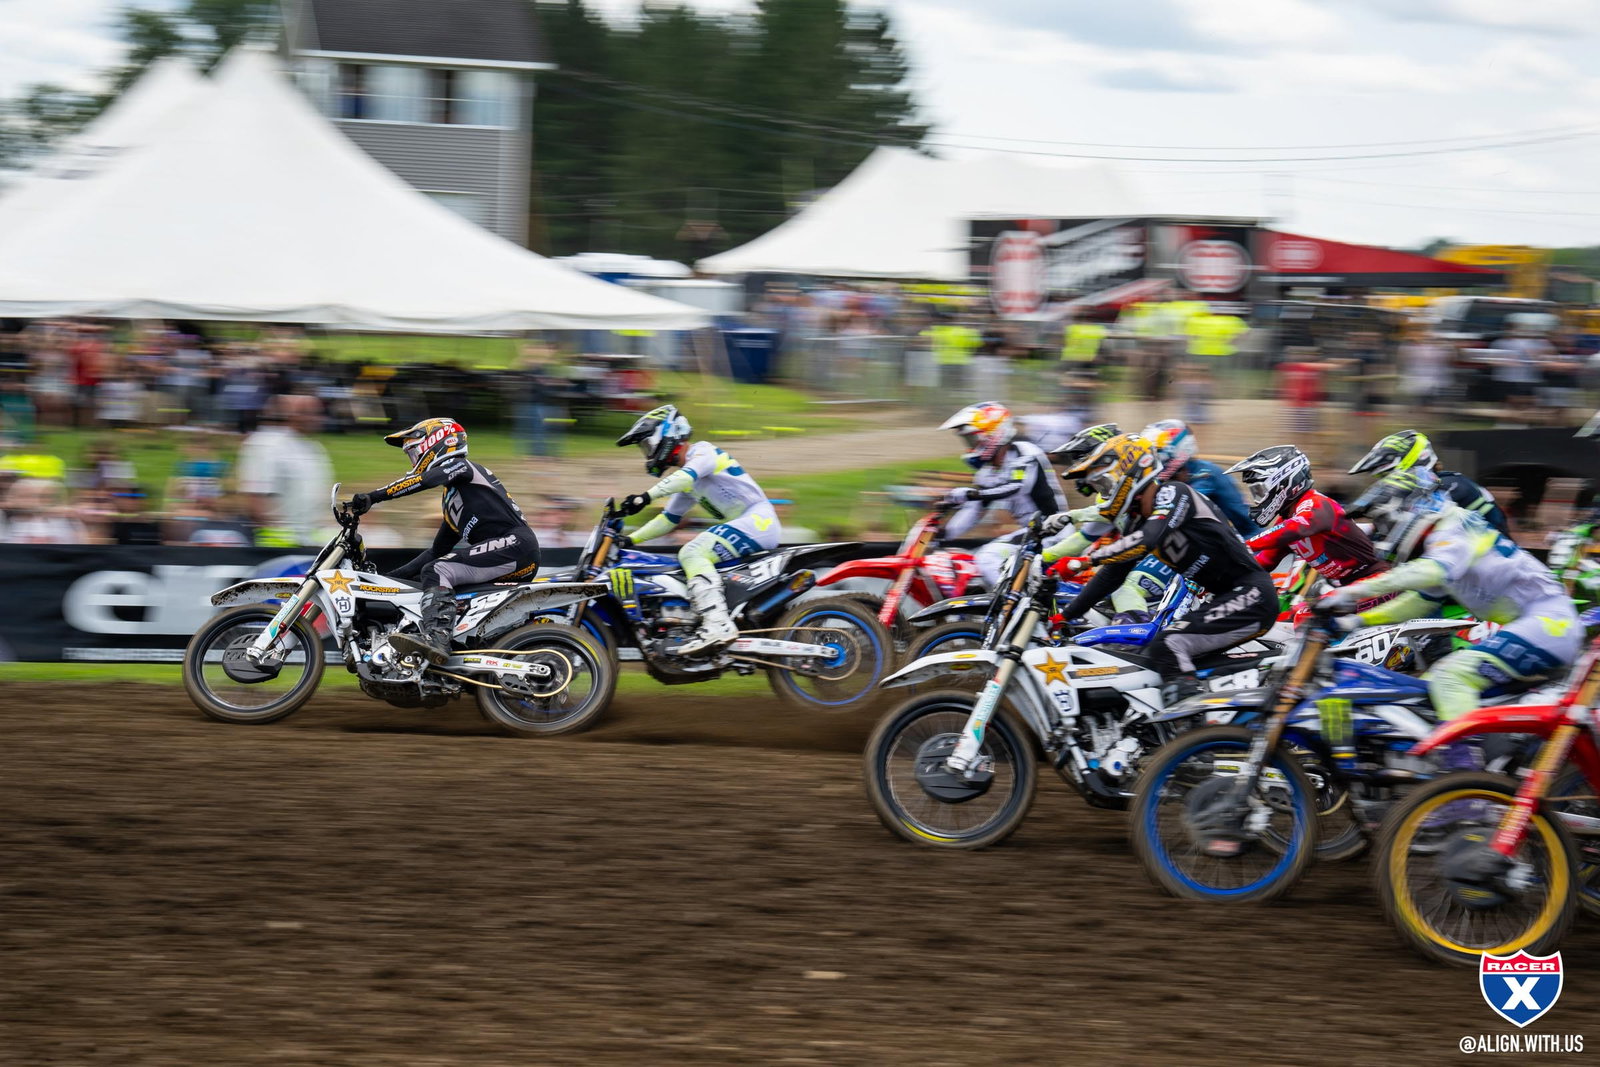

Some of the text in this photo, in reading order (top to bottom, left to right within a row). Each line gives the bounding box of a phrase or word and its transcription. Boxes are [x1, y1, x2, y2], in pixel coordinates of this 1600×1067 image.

[420, 424, 456, 453] 100%
[386, 475, 423, 496] ROCKSTAR
[360, 584, 400, 593] ROCKSTAR
[466, 590, 511, 616] 59
[1355, 632, 1391, 664] 60
